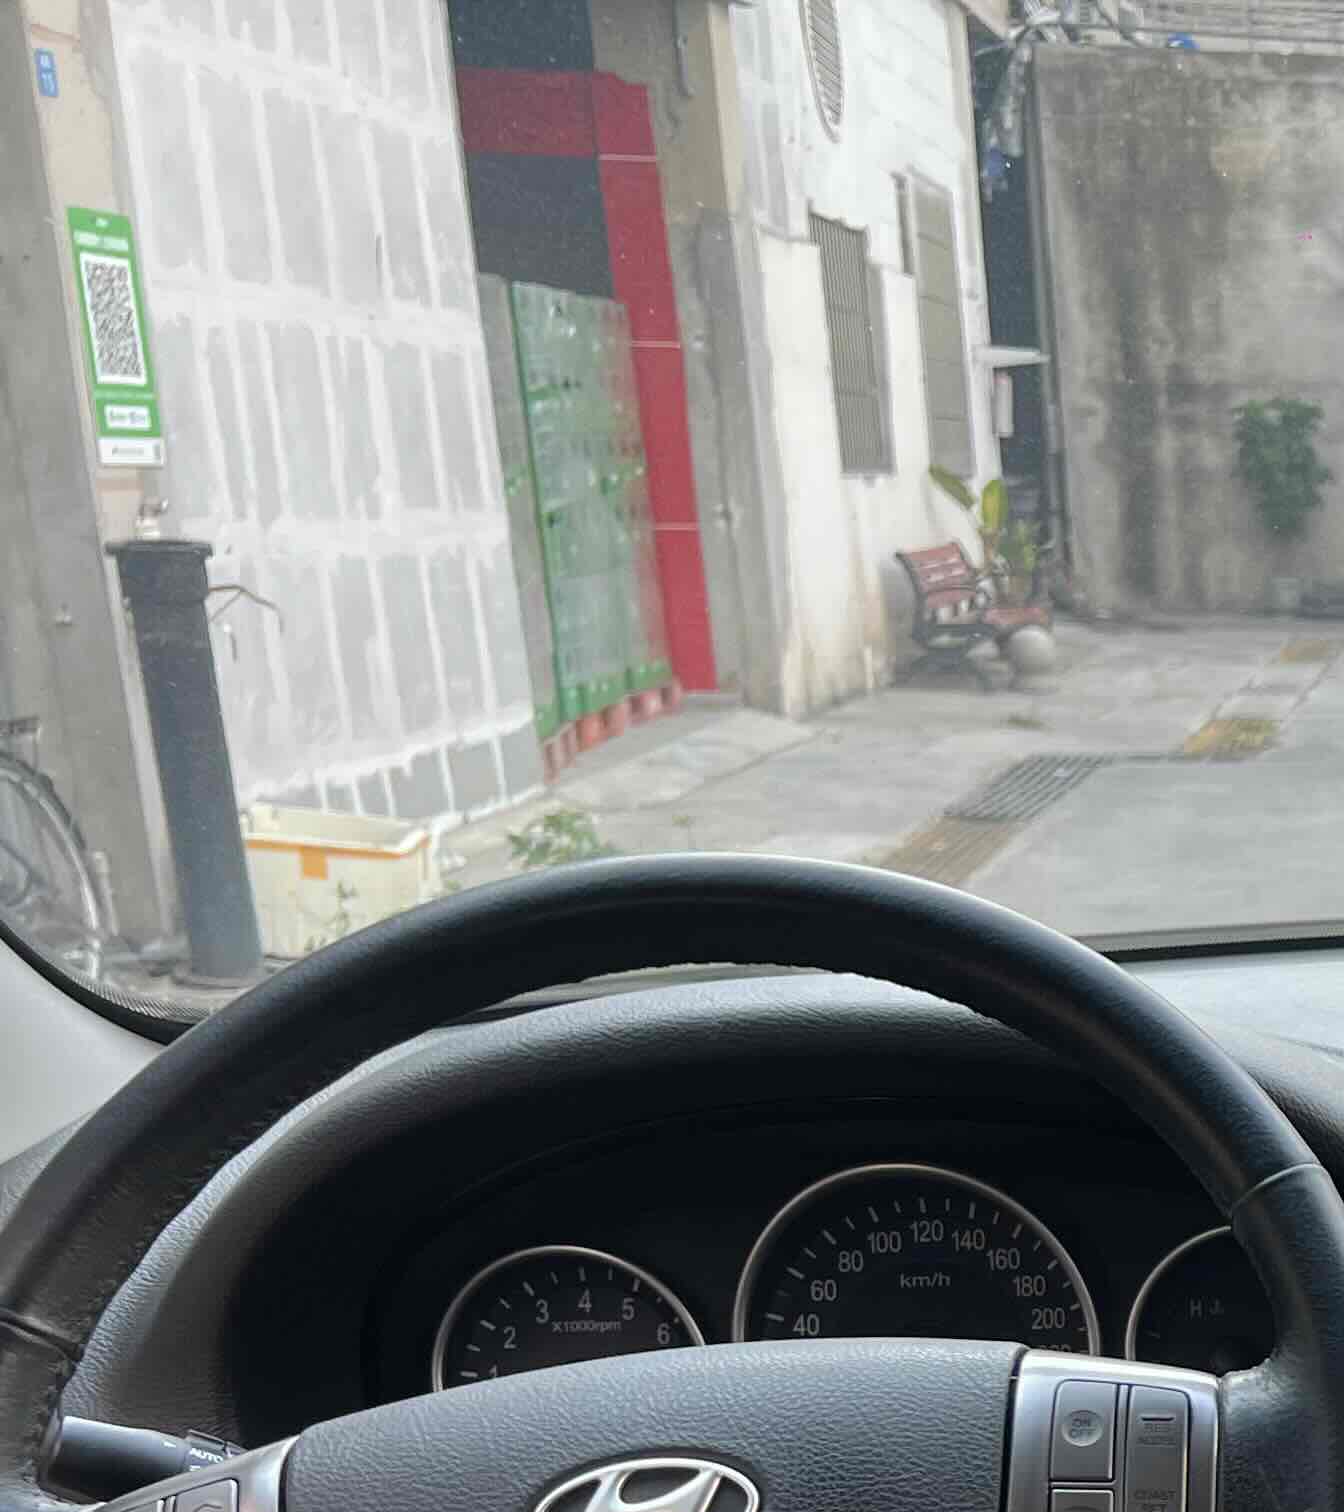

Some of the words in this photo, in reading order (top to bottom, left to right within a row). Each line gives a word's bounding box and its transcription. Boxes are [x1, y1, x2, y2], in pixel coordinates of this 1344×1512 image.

[867, 1231, 901, 1253] 100
[910, 1221, 944, 1243] 120
[952, 1228, 985, 1250] 140
[838, 1251, 864, 1273] 80
[986, 1249, 1020, 1271] 160
[810, 1279, 837, 1302] 60
[900, 1272, 951, 1289] km/h
[1012, 1275, 1047, 1297] 180
[536, 1300, 549, 1323] 3
[578, 1290, 592, 1313] 4
[622, 1299, 635, 1320] 5
[793, 1313, 820, 1337] 40
[1031, 1308, 1066, 1330] 200
[503, 1327, 517, 1349] 2
[656, 1324, 670, 1345] 6
